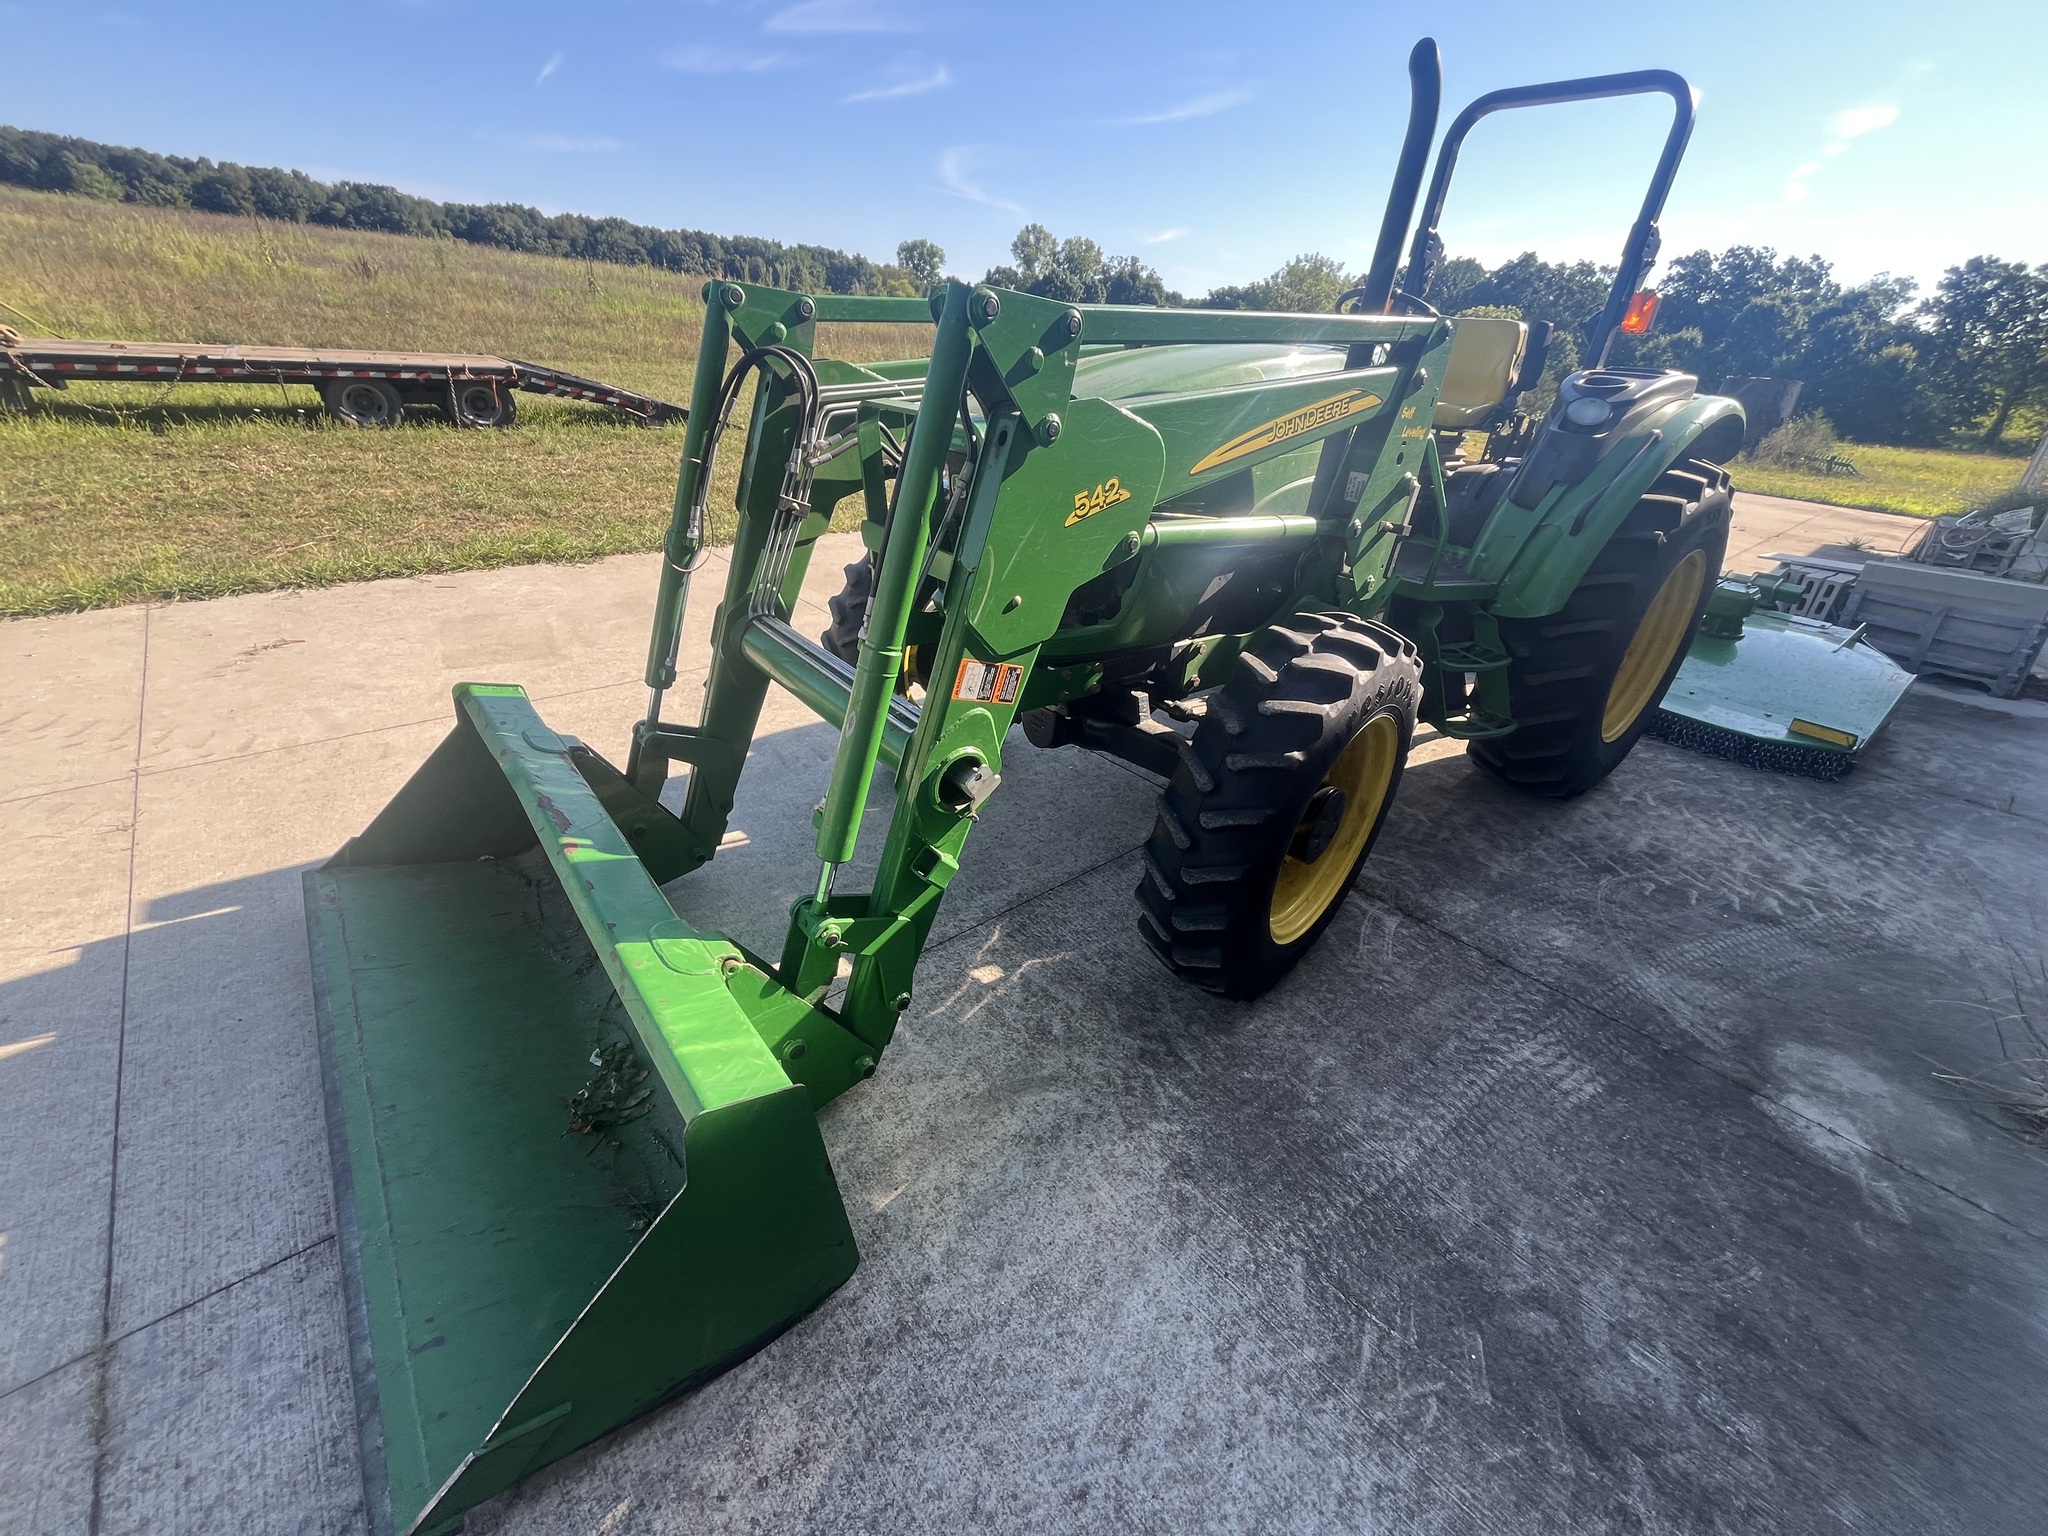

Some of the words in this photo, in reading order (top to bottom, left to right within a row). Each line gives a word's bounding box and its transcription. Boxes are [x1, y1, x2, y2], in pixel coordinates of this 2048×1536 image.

[1267, 413, 1306, 442] JOHN
[1305, 398, 1350, 427] DEERE
[1074, 476, 1120, 518] 542
